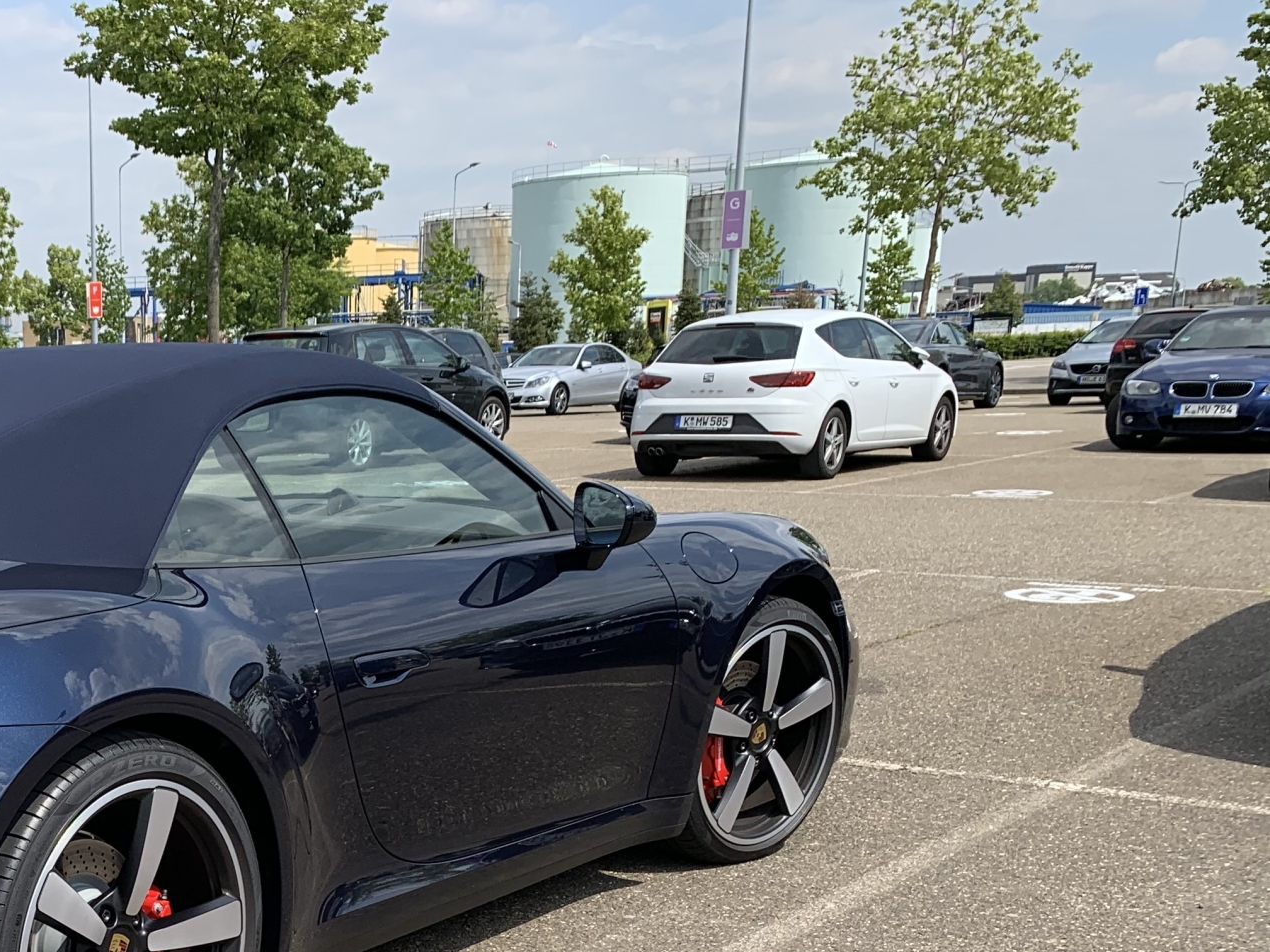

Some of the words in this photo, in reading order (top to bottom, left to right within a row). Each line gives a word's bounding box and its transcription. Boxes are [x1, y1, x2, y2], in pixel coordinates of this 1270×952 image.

[730, 197, 740, 210] G
[1183, 404, 1191, 414] K
[1213, 404, 1233, 414] 784
[683, 416, 690, 427] K
[695, 416, 709, 427] MW
[709, 416, 729, 427] 585
[110, 754, 177, 776] ZERO
